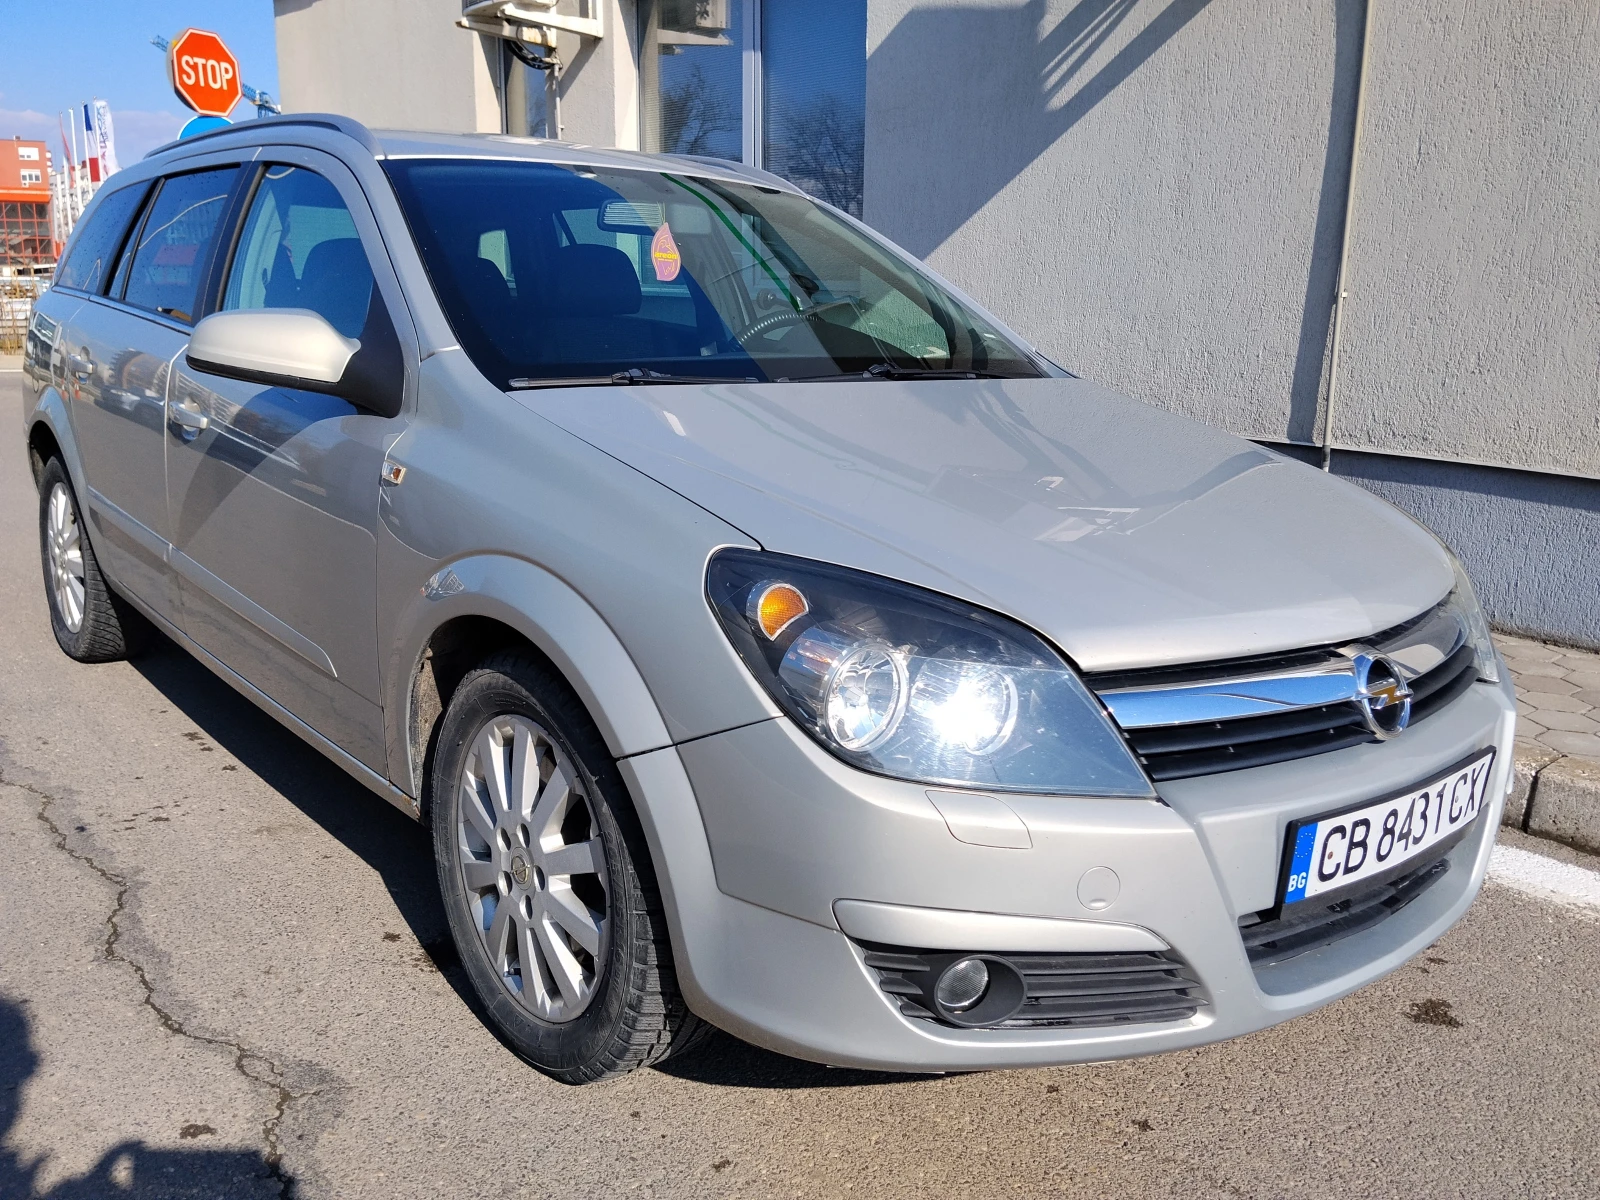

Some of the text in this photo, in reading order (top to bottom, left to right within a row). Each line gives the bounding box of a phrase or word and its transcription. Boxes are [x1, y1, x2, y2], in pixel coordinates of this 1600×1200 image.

[181, 55, 233, 90] STOP
[1318, 762, 1485, 882] CB 8431 CX
[1287, 872, 1307, 892] BG
